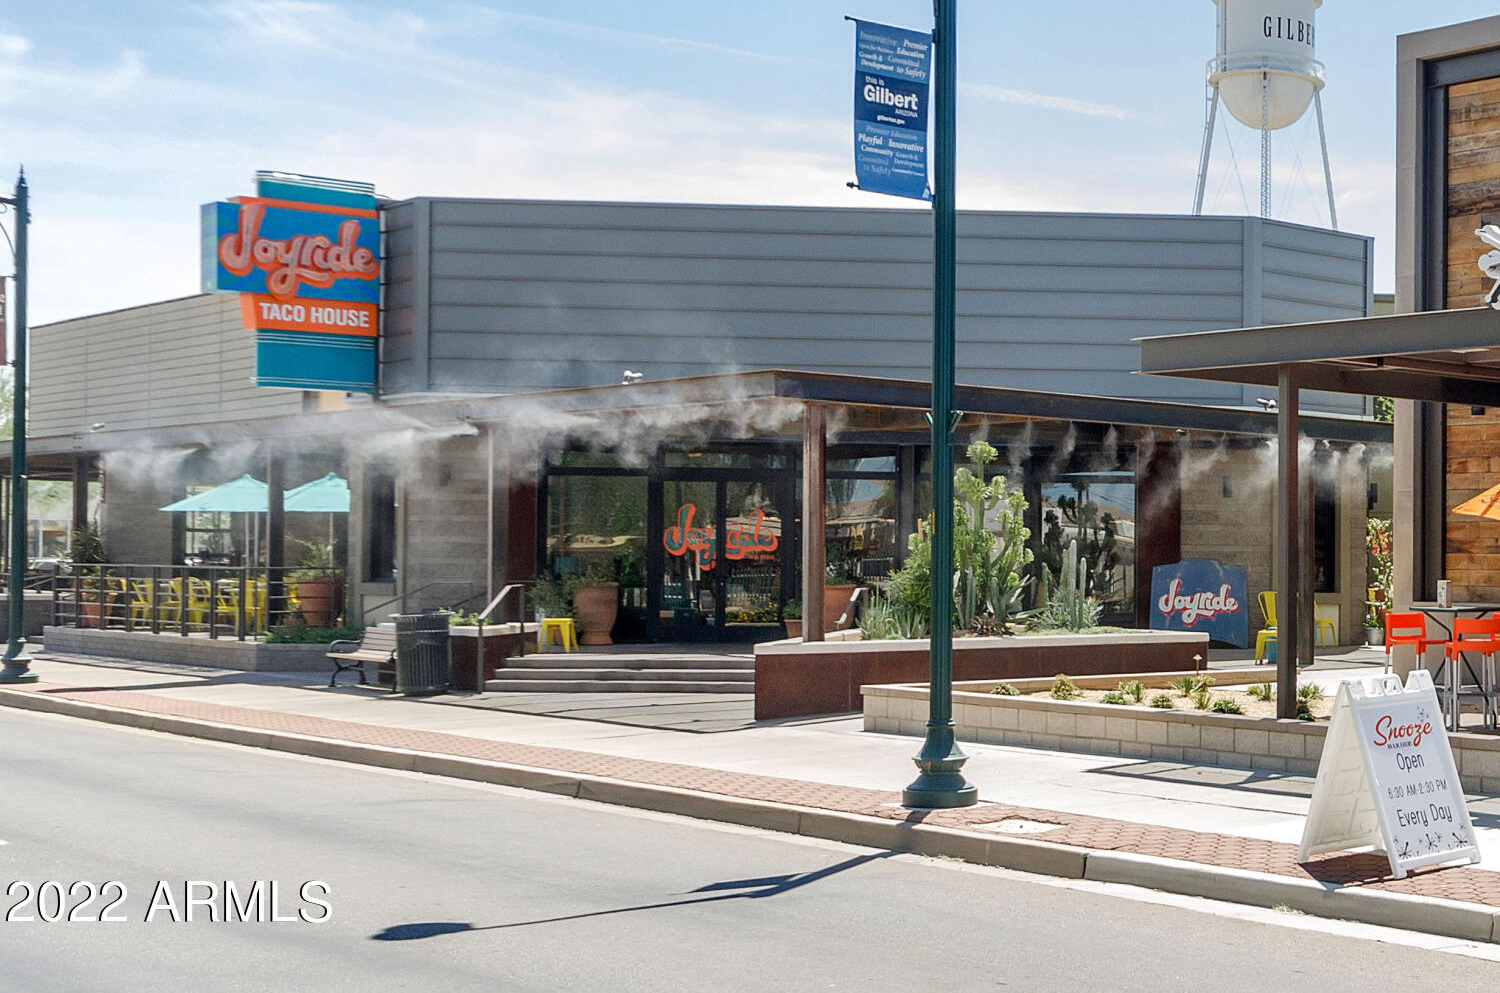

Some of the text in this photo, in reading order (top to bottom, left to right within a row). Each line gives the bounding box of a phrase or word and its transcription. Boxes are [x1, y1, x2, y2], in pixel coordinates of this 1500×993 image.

[896, 47, 925, 59] Education
[904, 39, 928, 51] Premier
[865, 75, 885, 86] this is
[905, 67, 926, 80] Safety
[863, 84, 918, 110] Gilbert
[895, 108, 918, 118] ARIZONA
[858, 133, 883, 146] Playful
[888, 138, 924, 153] Innovative
[218, 202, 378, 300] Joyride
[259, 302, 370, 328] TACO HOUSE
[1158, 578, 1240, 627] Joyride
[1373, 715, 1433, 748] Snooze
[1396, 752, 1425, 773] Open
[1387, 785, 1404, 799] 6:30
[1435, 778, 1448, 791] PM
[1396, 803, 1453, 827] Every Day
